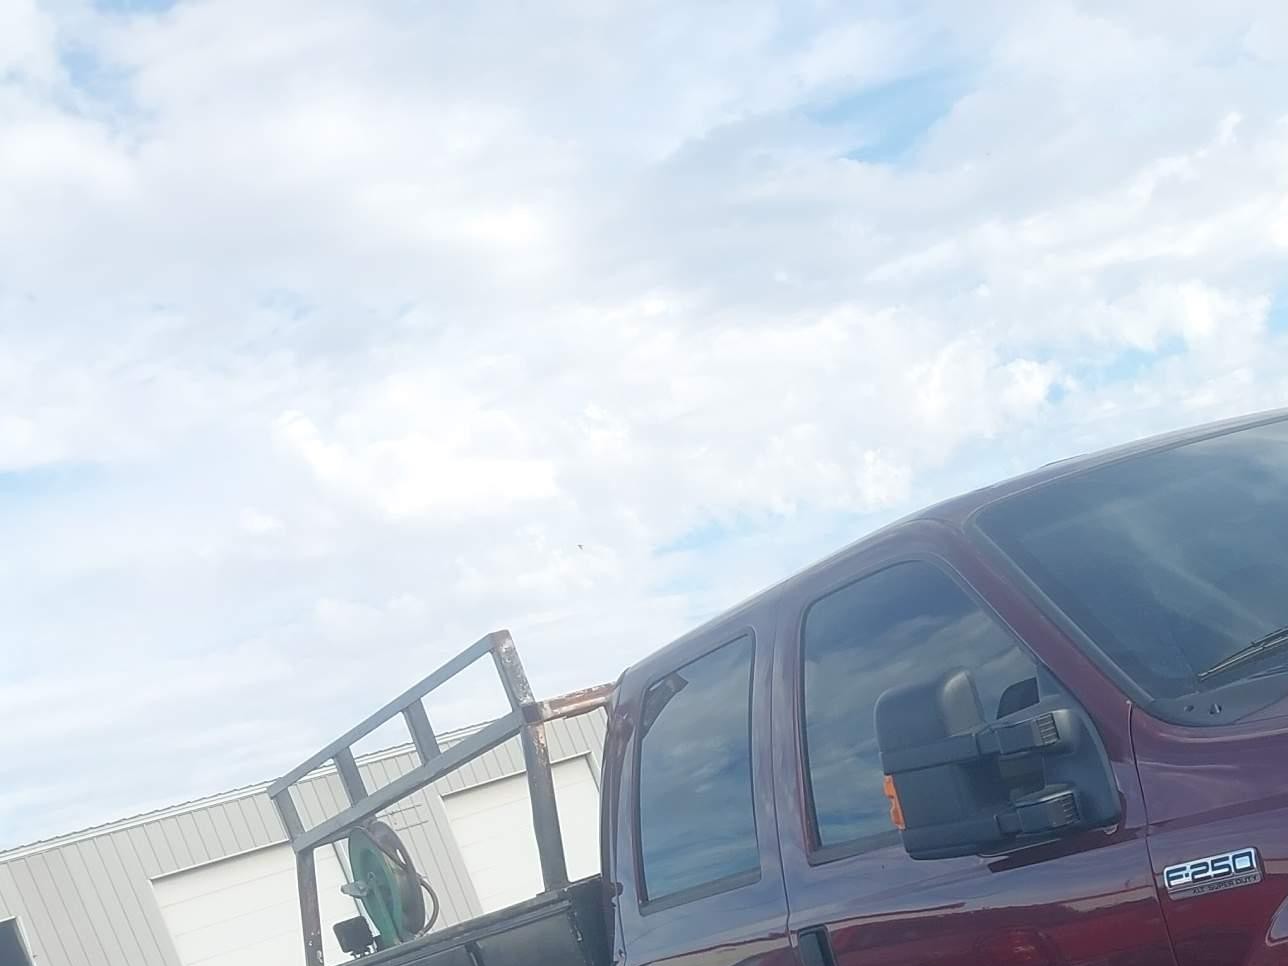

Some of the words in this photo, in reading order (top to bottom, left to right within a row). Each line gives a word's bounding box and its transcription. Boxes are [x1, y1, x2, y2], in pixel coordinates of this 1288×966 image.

[1165, 851, 1256, 888] F-250
[1208, 880, 1234, 892] SUPER
[1235, 873, 1258, 885] DUTY
